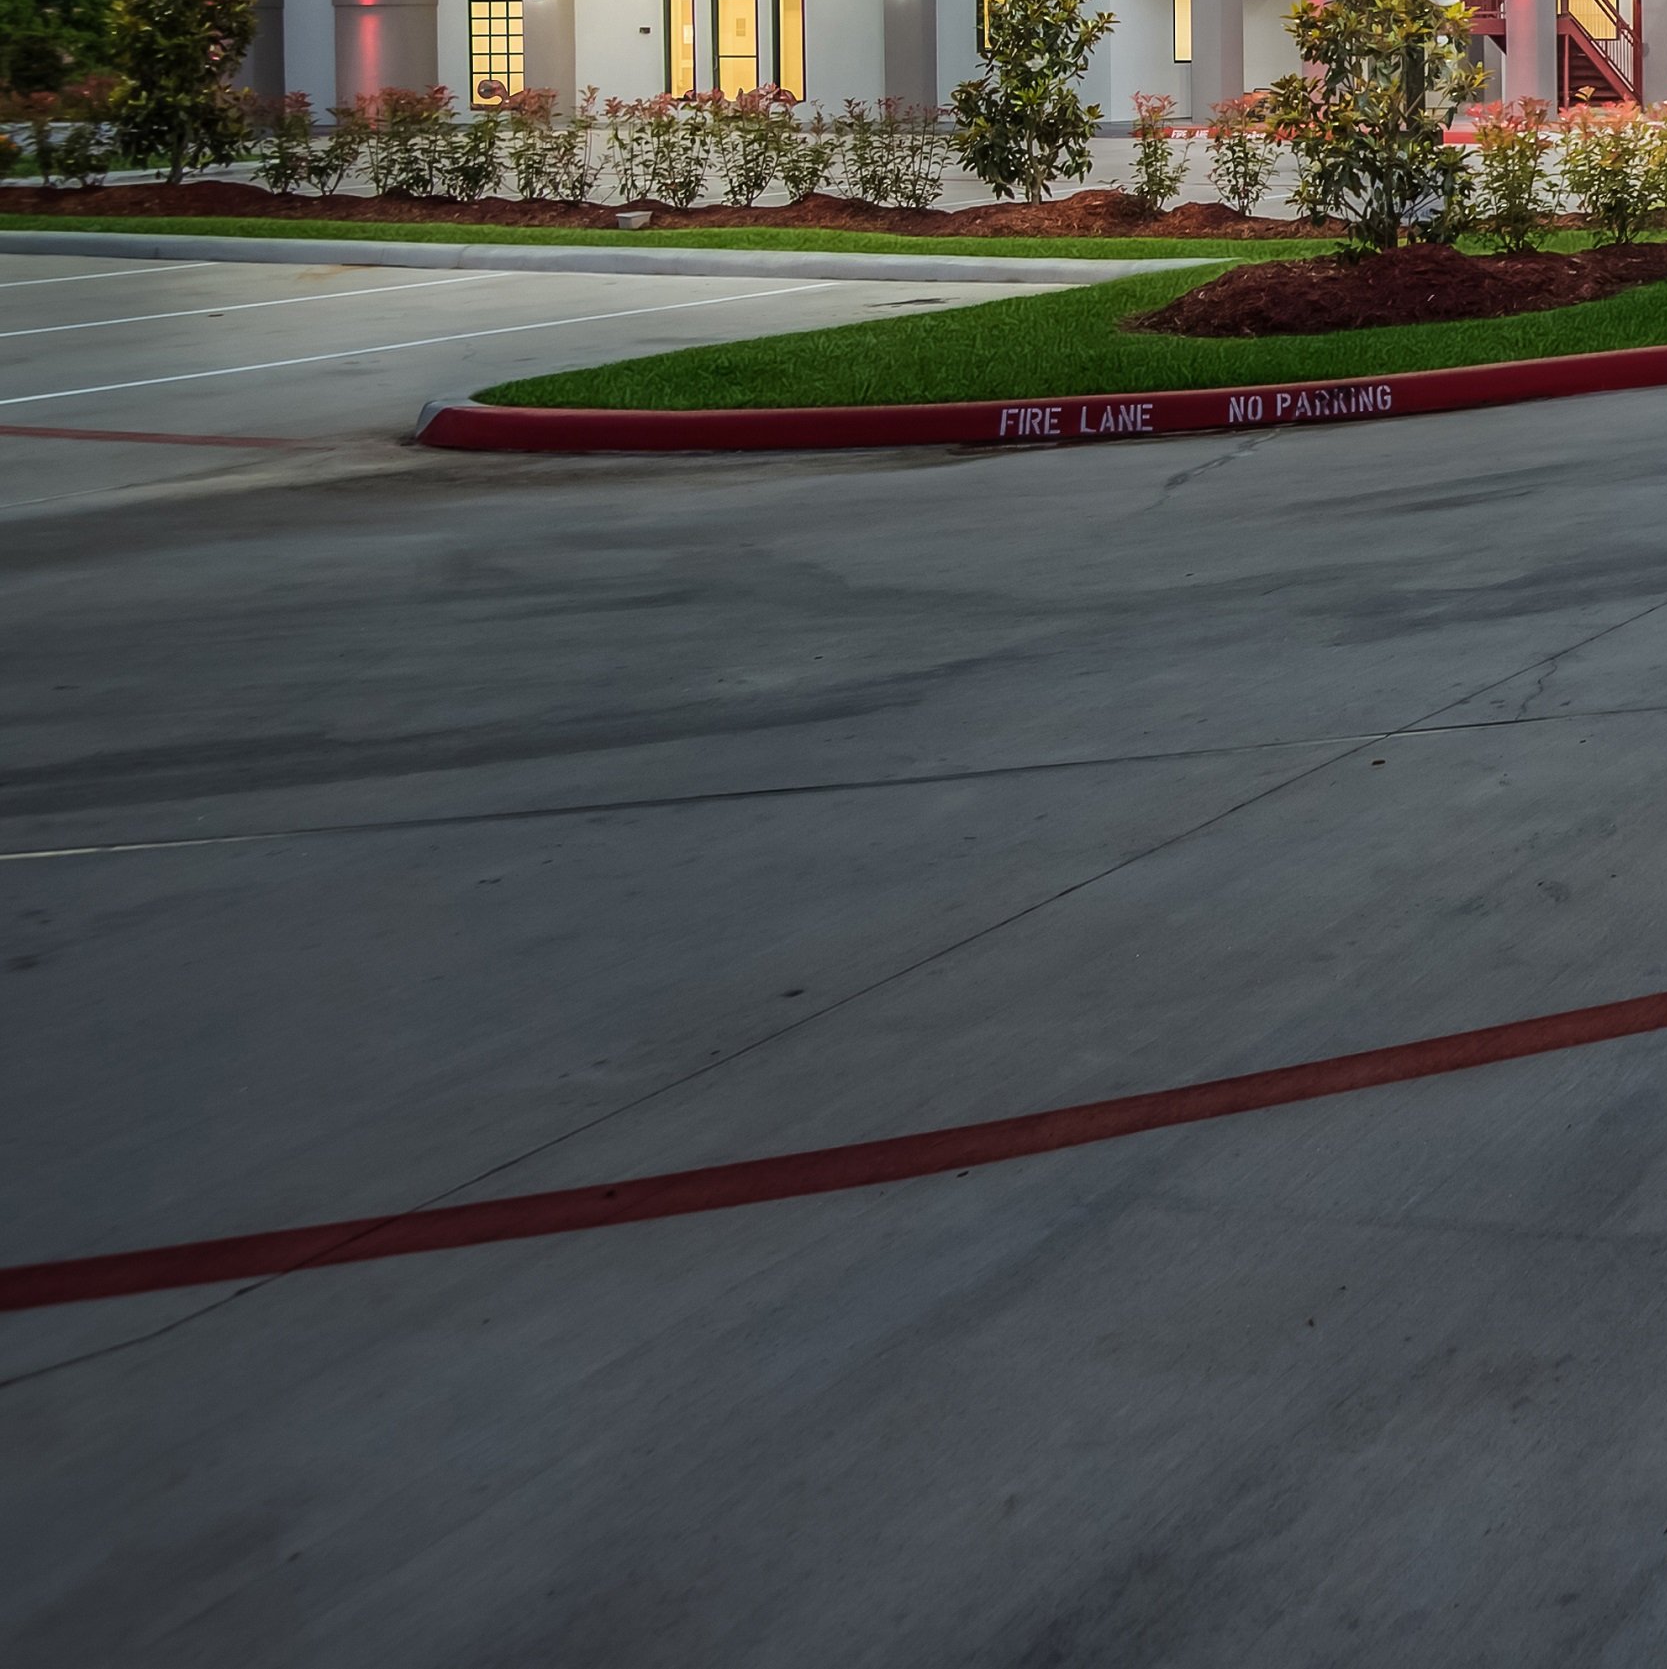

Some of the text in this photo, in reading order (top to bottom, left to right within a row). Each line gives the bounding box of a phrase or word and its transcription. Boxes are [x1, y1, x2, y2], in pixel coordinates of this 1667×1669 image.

[1000, 403, 1153, 436] FIRE LANE
[1228, 384, 1392, 423] NO PARKING
